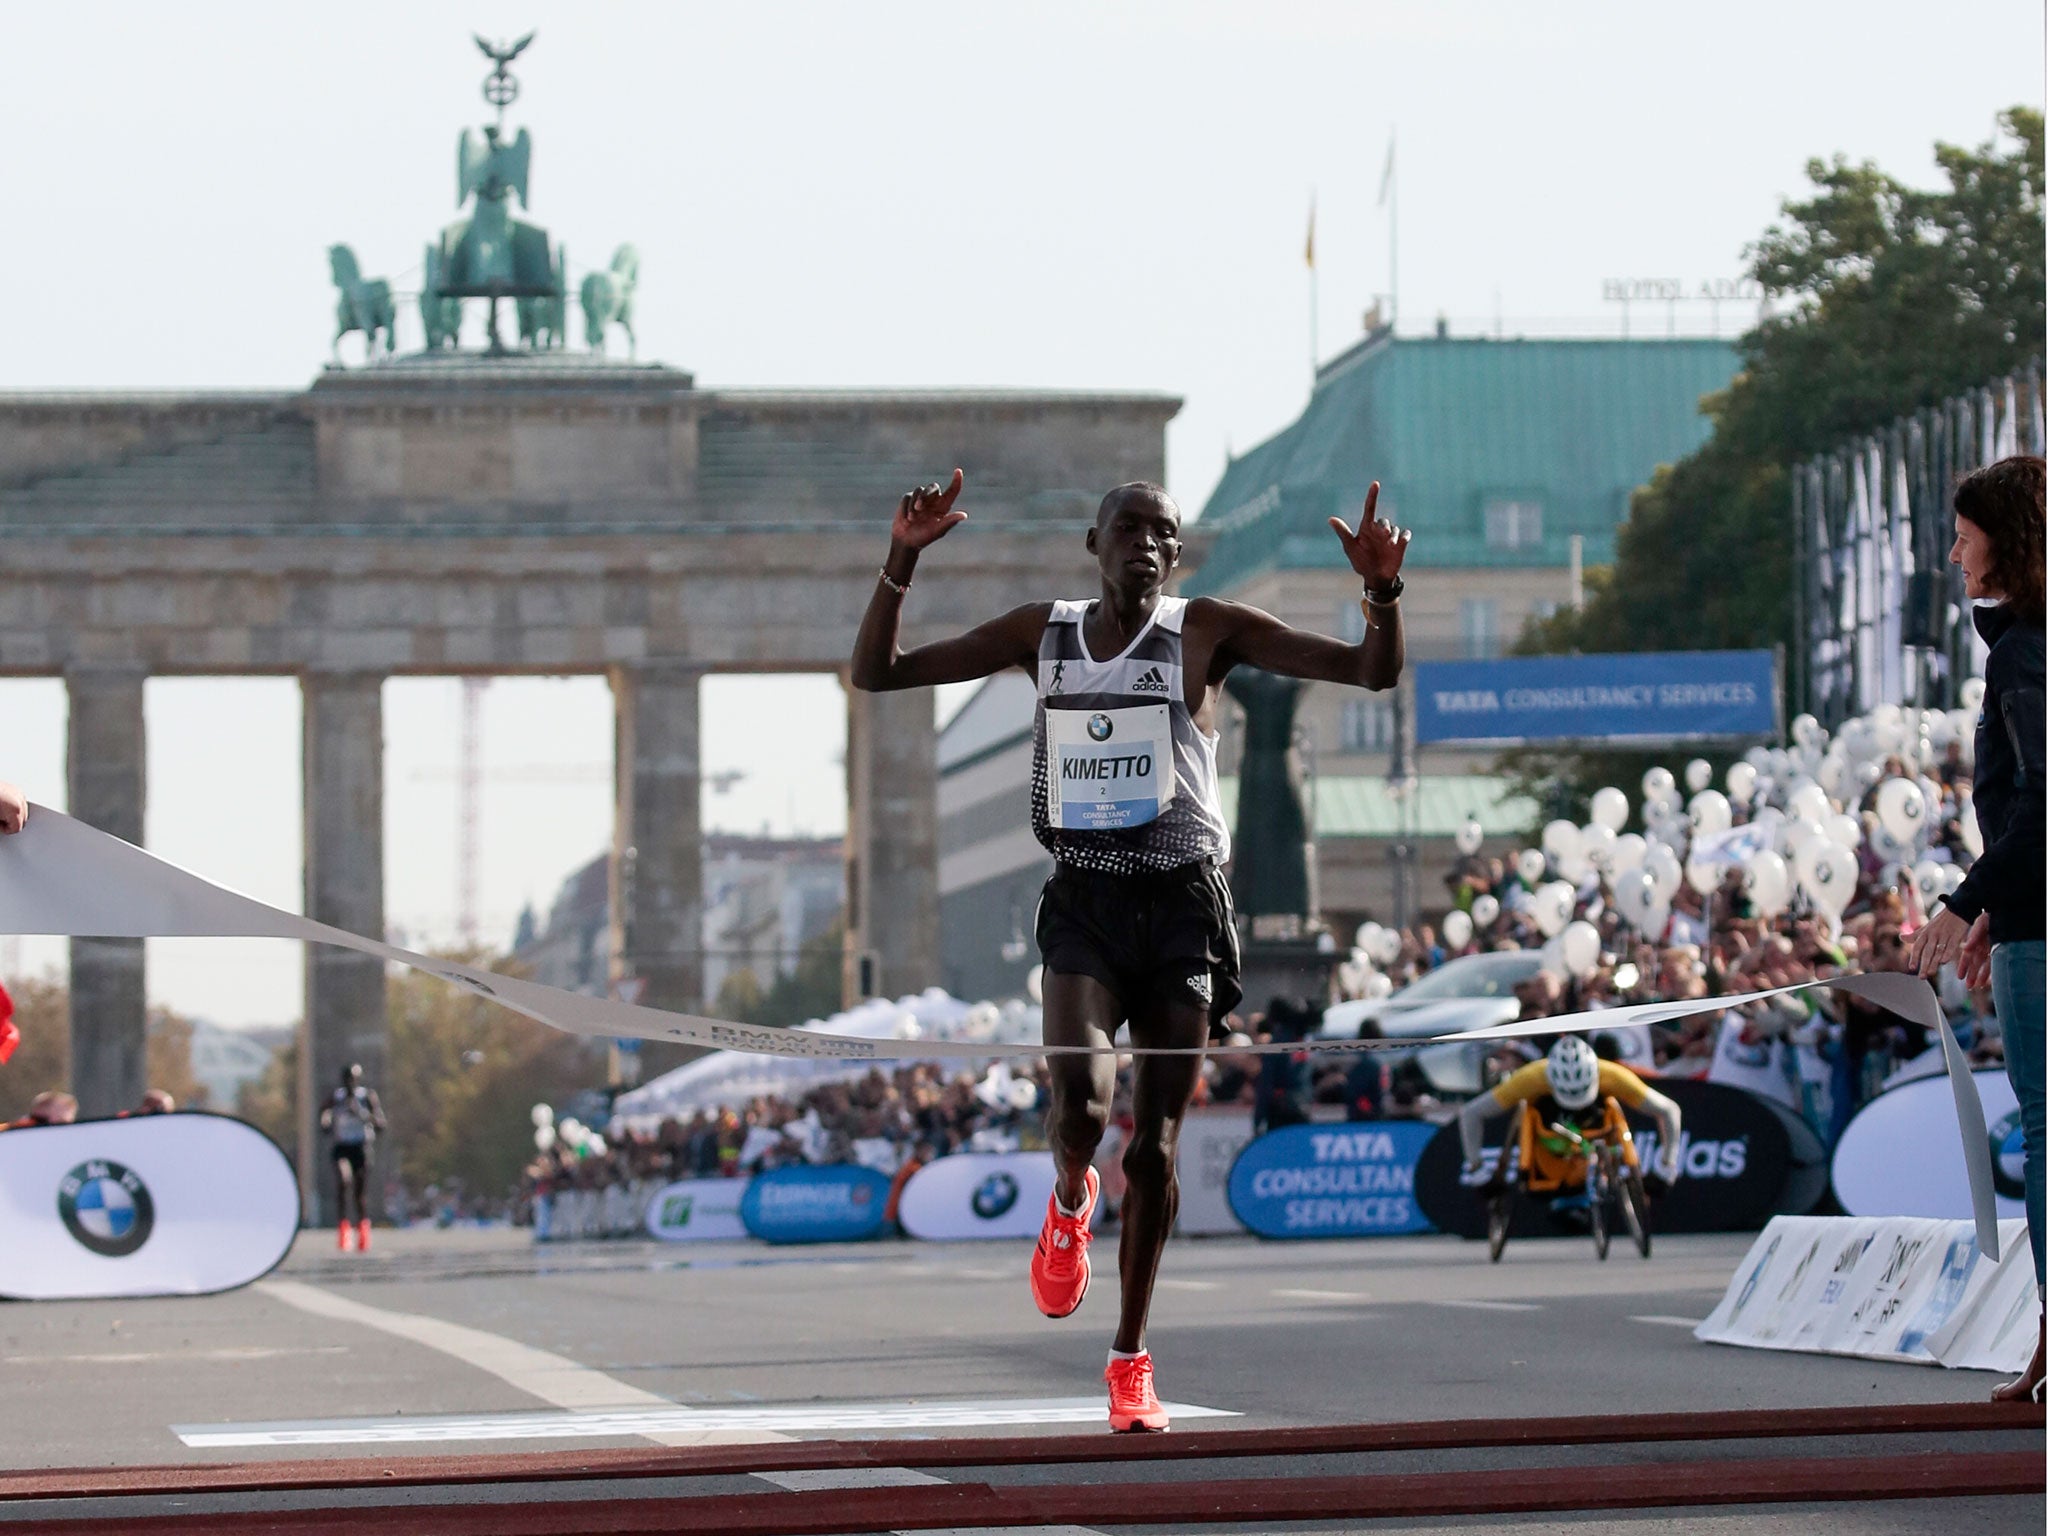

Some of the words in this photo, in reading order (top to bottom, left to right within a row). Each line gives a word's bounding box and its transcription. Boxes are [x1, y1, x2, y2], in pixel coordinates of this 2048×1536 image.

[1602, 277, 1687, 299] HOTEL
[1132, 682, 1169, 692] adidas
[1435, 691, 1499, 712] TATA
[1504, 687, 1655, 710] CONSULTANCY
[1658, 682, 1757, 707] SERVICES
[1062, 754, 1152, 780] KIMETTO
[1100, 787, 1106, 795] 2
[1082, 810, 1131, 819] CONSULTANCY
[1091, 819, 1123, 827] SERVICES
[1311, 1133, 1395, 1161] TATA
[1253, 1165, 1413, 1197] CONSULTAN
[1284, 1198, 1410, 1227] SERVICES
